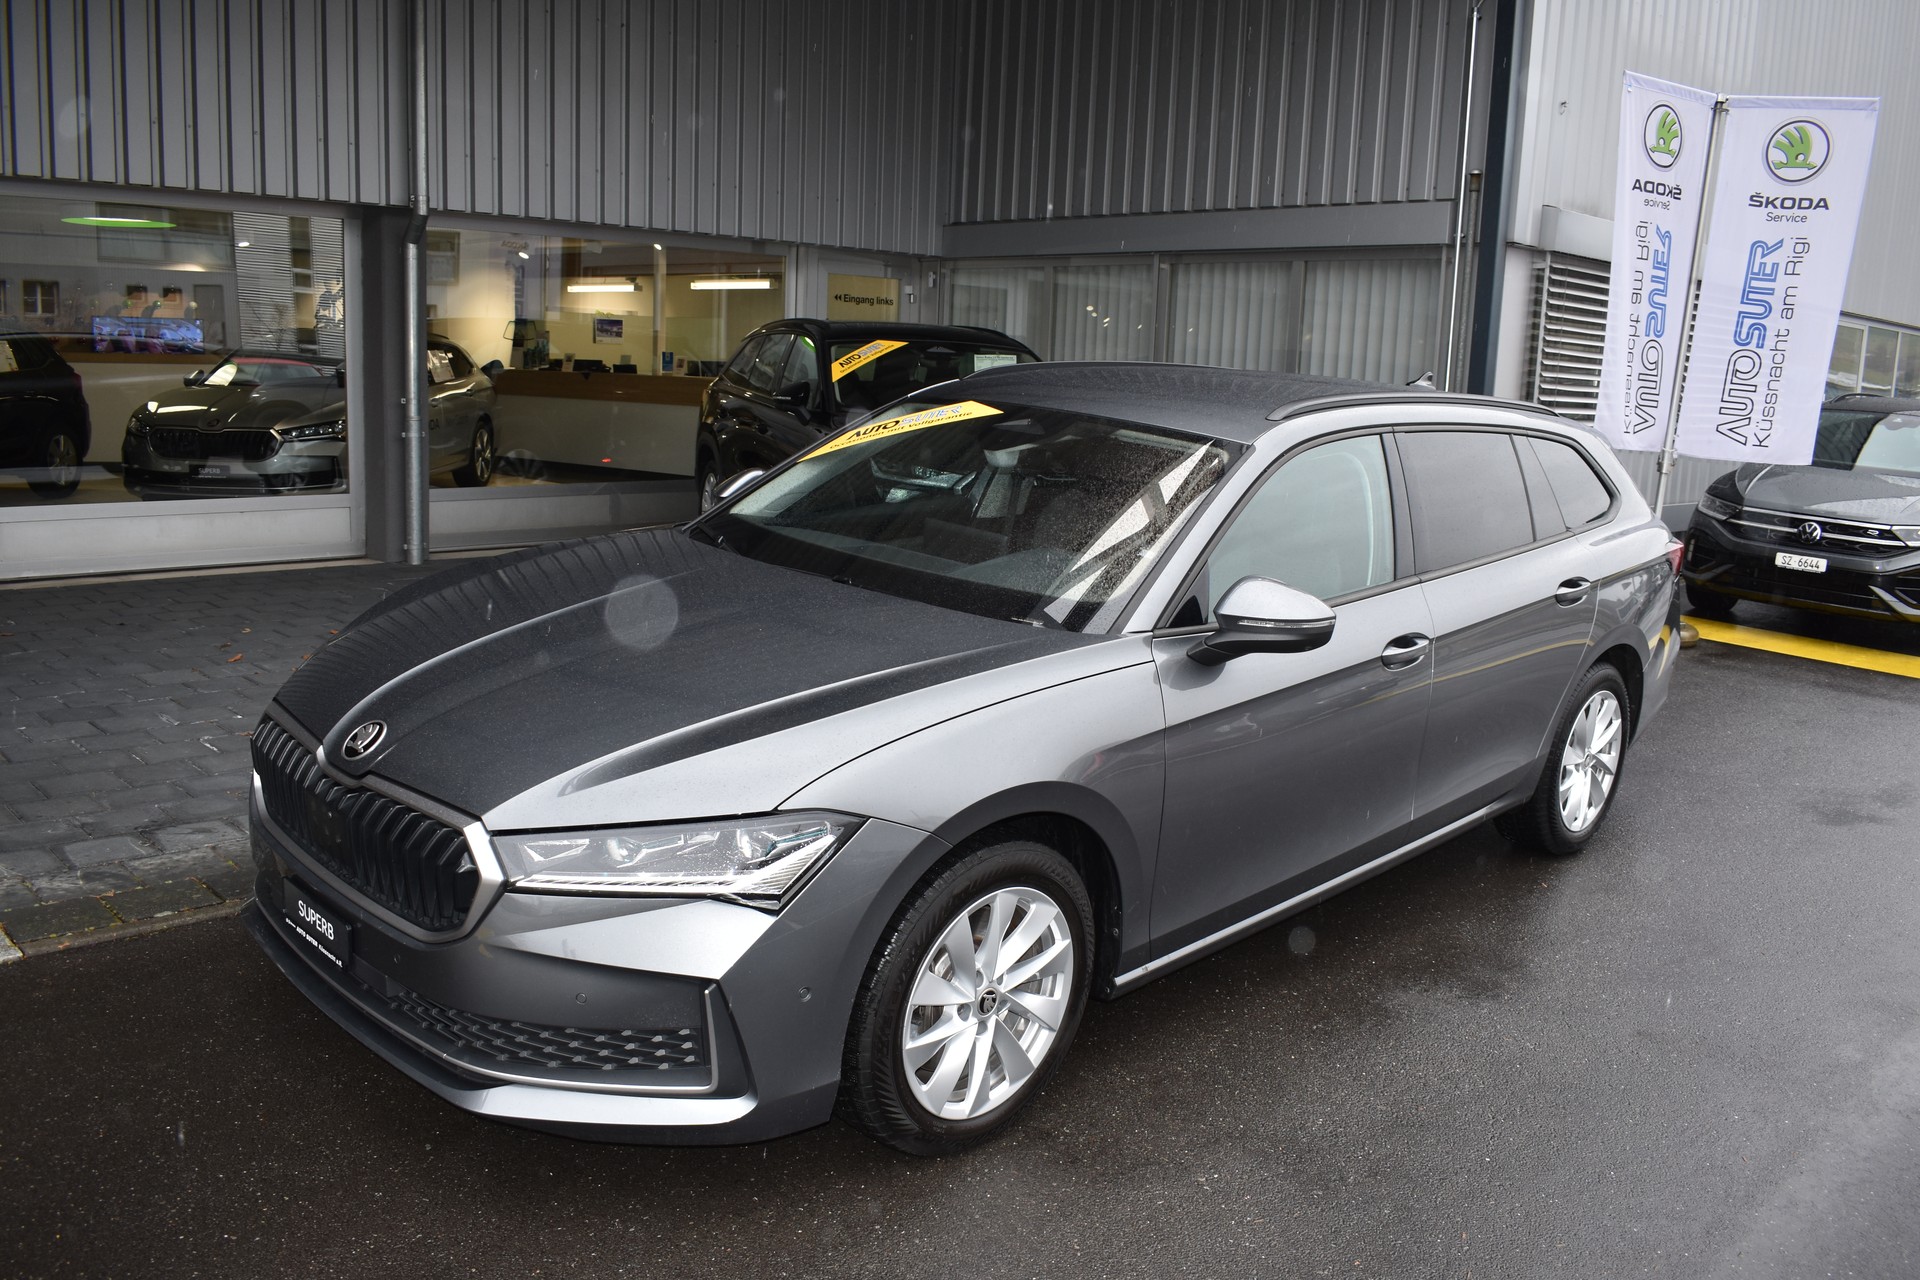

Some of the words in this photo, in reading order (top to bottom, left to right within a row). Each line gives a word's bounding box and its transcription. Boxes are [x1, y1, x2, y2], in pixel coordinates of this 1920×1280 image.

[1747, 192, 1829, 210] ŠKODA
[1765, 211, 1808, 223] Service
[1784, 237, 1810, 276] Rigi
[843, 293, 875, 306] Eingang
[876, 296, 894, 306] links
[1780, 286, 1798, 320] am
[1752, 328, 1790, 448] Küssnacht
[1781, 555, 1793, 566] SZ
[1797, 557, 1820, 569] 6644
[298, 900, 334, 940] SUPERB
